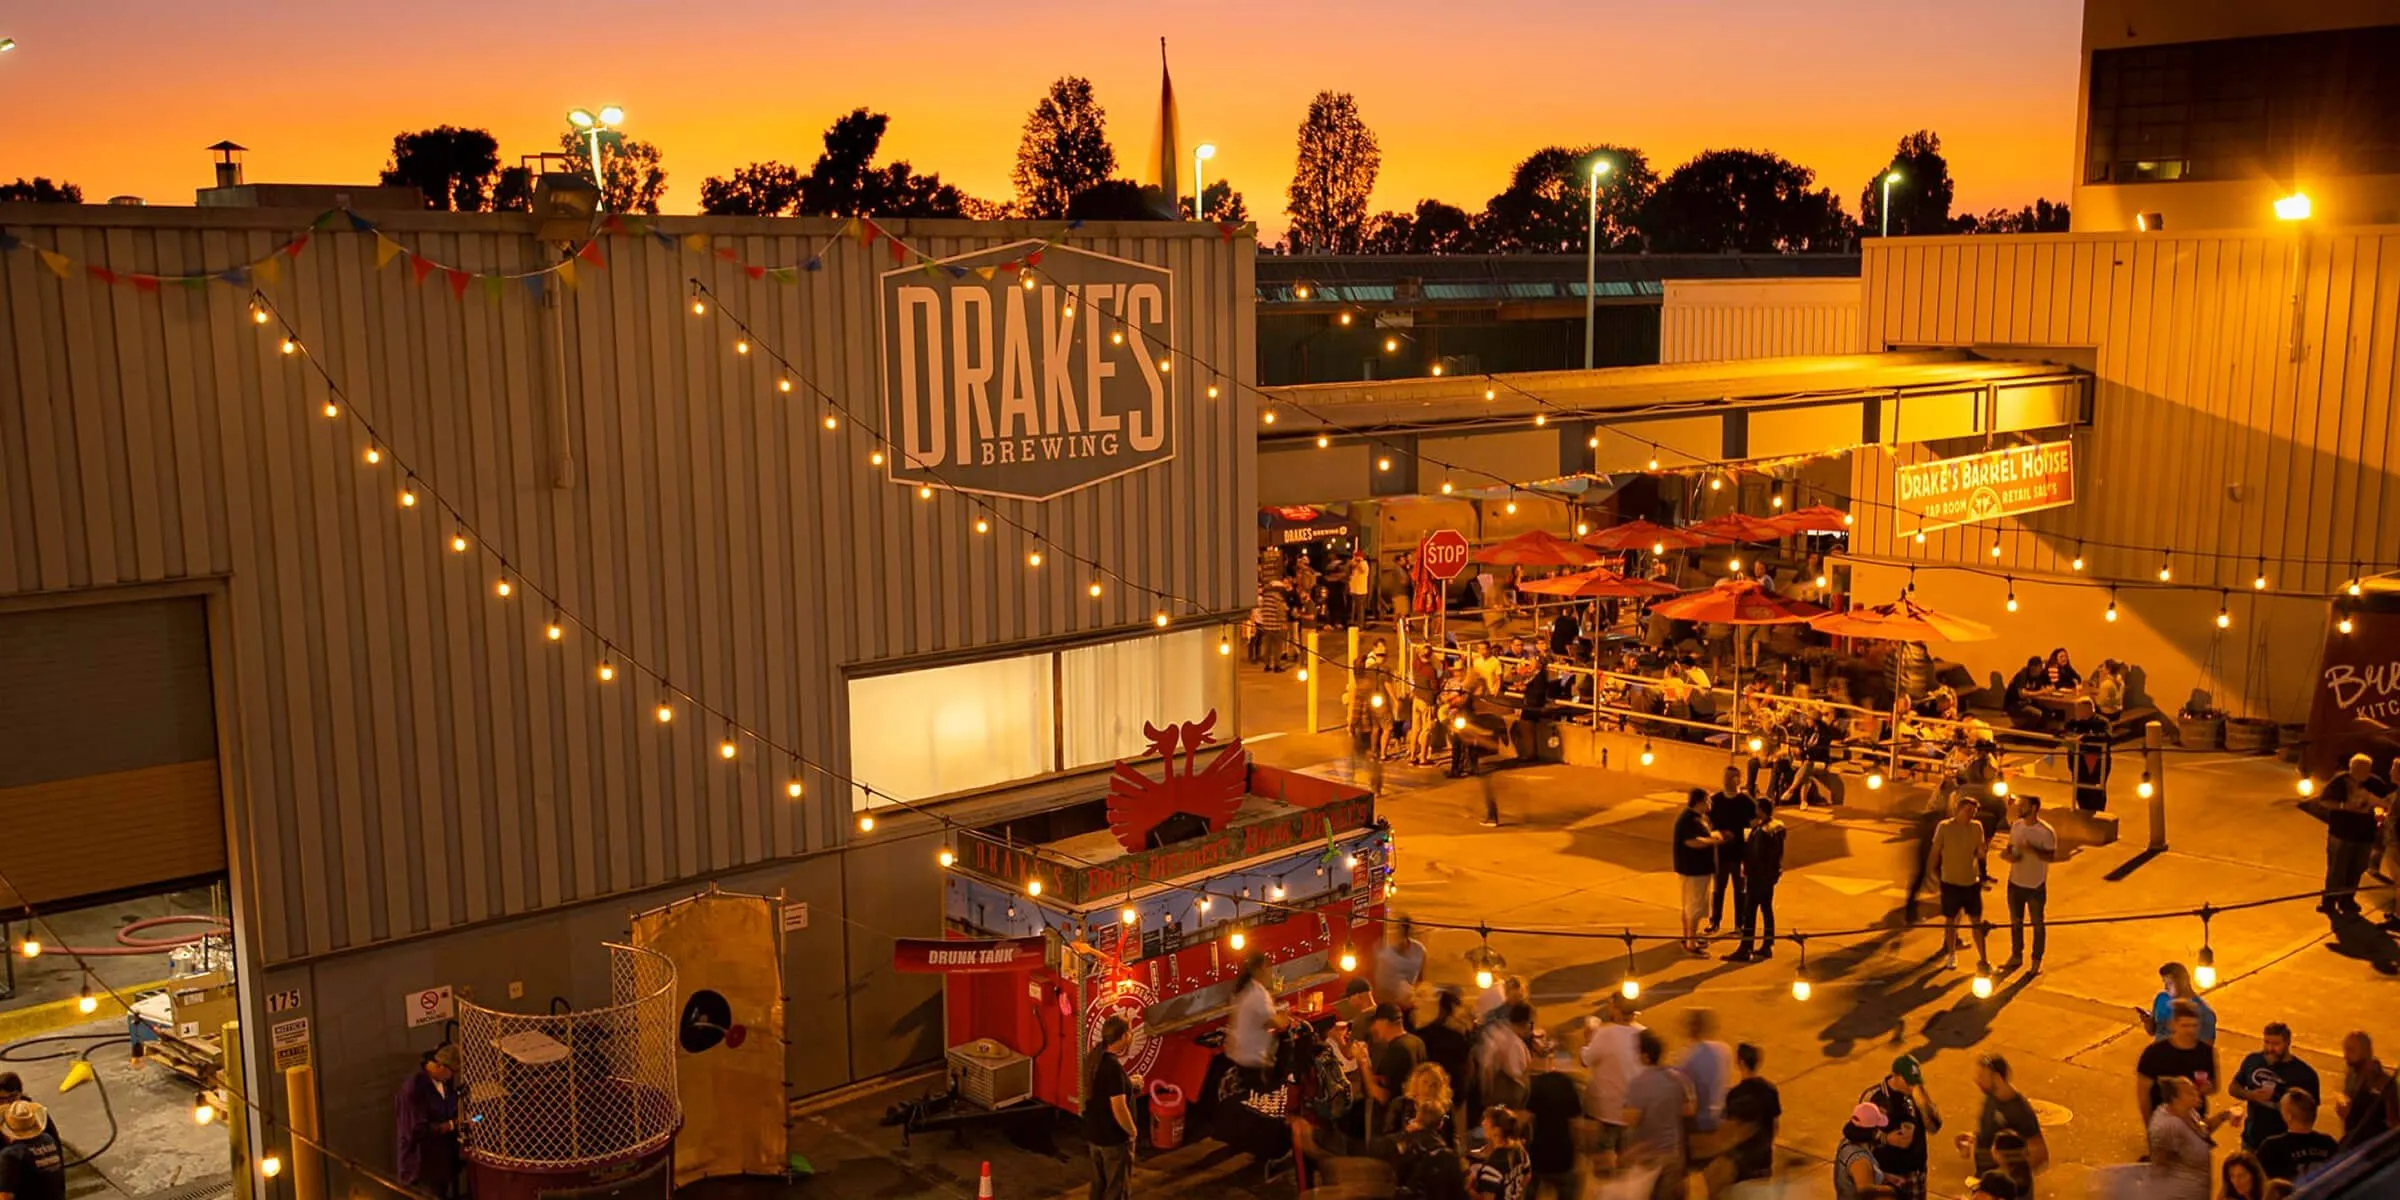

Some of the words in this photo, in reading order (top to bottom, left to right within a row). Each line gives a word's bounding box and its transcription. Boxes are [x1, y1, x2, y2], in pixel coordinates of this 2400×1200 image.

[898, 283, 1164, 470] DRAKE'S
[981, 433, 1120, 466] BREWING
[1901, 465, 1959, 500] DRAKE'S
[1962, 456, 2018, 490] BARREL
[2022, 450, 2069, 480] HOUSE
[1926, 503, 1941, 518] TAP
[1943, 498, 1967, 515] ROOM
[2002, 487, 2032, 504] RETAIL
[1428, 545, 1465, 564] STOP
[928, 950, 976, 965] DRUNK
[979, 948, 1014, 964] TANK
[270, 990, 299, 1012] 175
